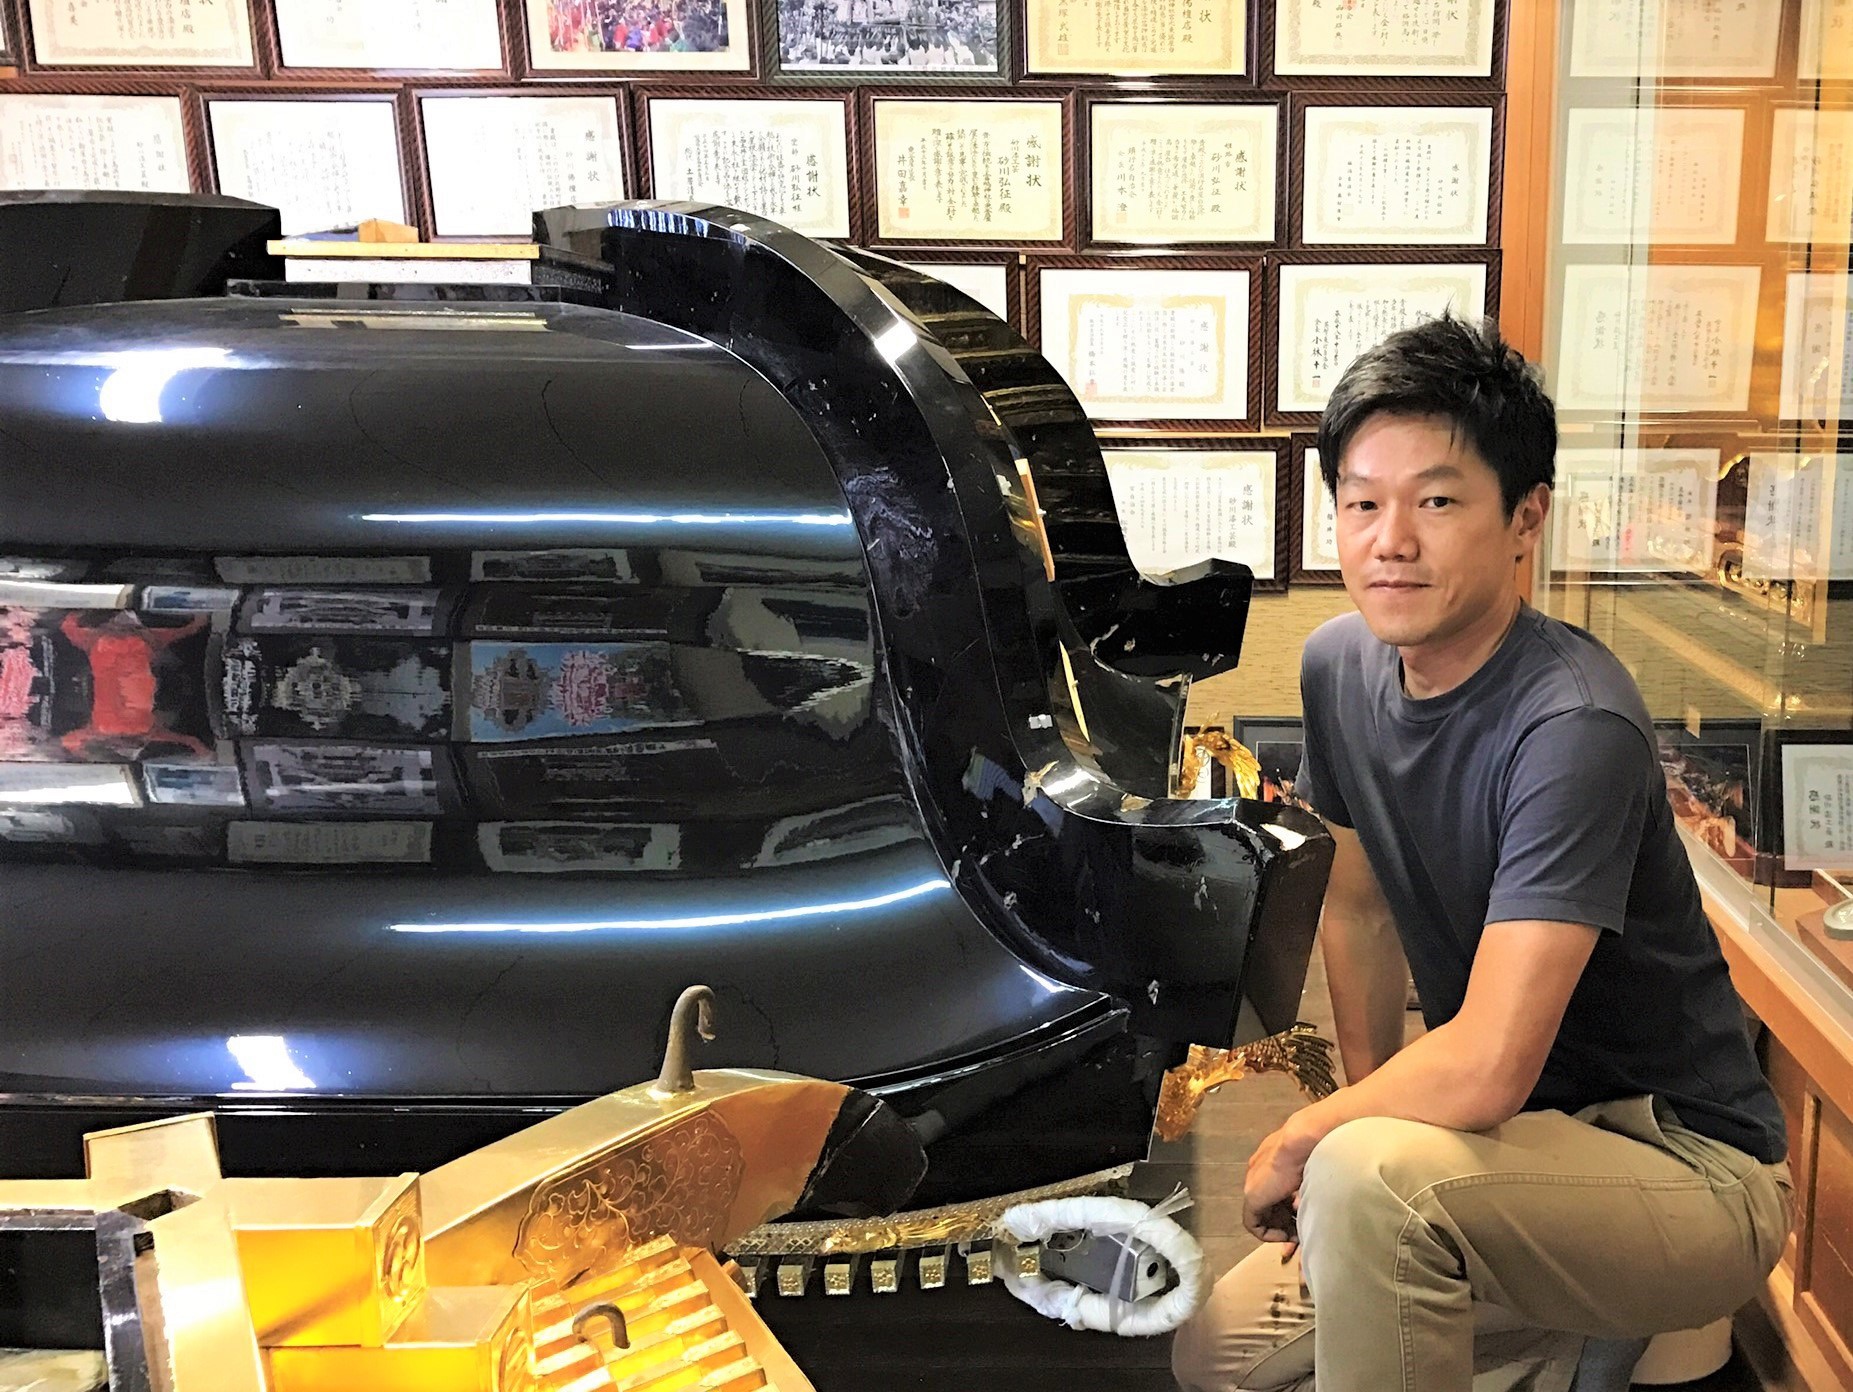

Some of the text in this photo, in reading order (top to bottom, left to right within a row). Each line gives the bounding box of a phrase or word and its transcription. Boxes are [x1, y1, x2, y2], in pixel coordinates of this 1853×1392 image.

[585, 129, 600, 182] 感謝状
[806, 153, 821, 197] 感謝状
[1025, 134, 1042, 187] 感謝状
[1234, 149, 1248, 192] 感謝状
[1241, 484, 1253, 526] 感謝状
